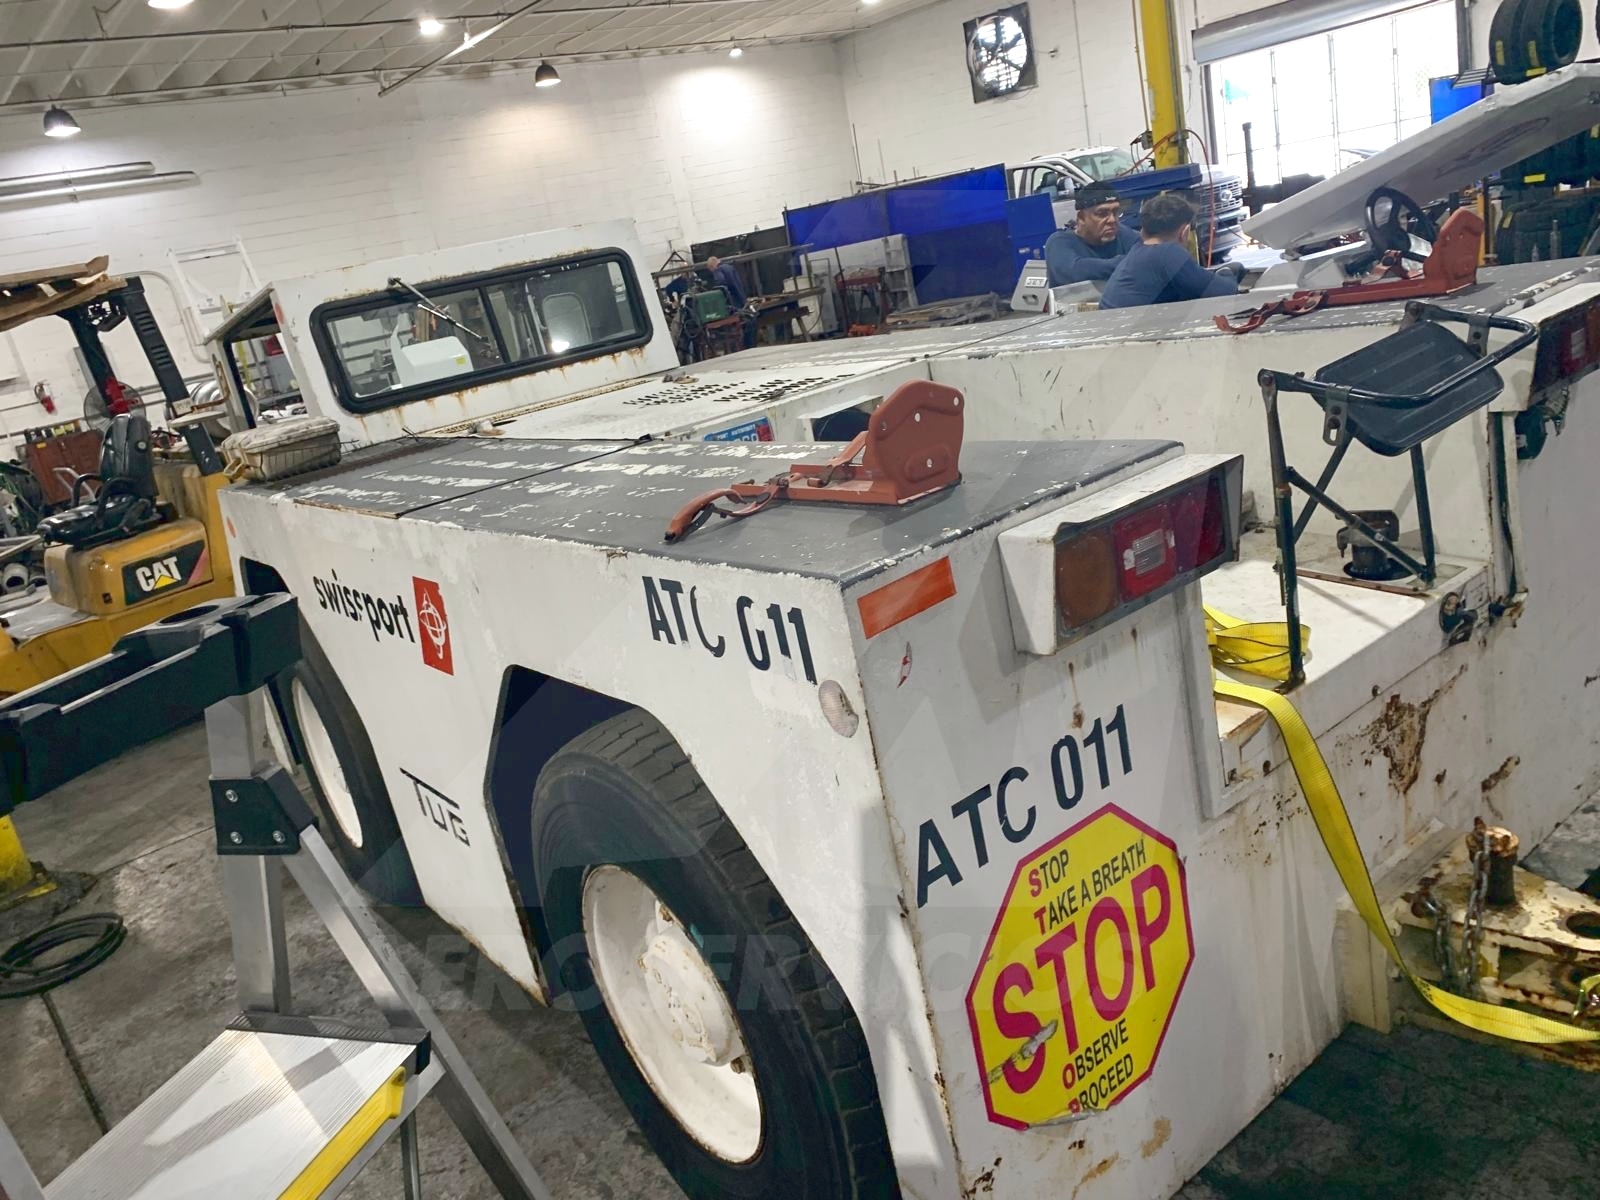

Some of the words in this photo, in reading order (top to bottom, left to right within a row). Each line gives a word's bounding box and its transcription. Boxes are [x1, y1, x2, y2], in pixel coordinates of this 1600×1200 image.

[136, 556, 182, 592] CAT
[313, 568, 416, 643] swissport
[642, 575, 726, 658] ATC
[399, 767, 470, 847] TUG
[916, 766, 1037, 909] ATC
[1051, 703, 1133, 810] 011
[1028, 849, 1069, 898] STOP
[1033, 885, 1079, 936] TAKE
[1081, 878, 1092, 908] A
[1091, 838, 1146, 898] BREATH
[992, 863, 1172, 1094] STOP
[1062, 1017, 1129, 1090] OBSERVE
[1067, 1053, 1134, 1114] PROCEED
